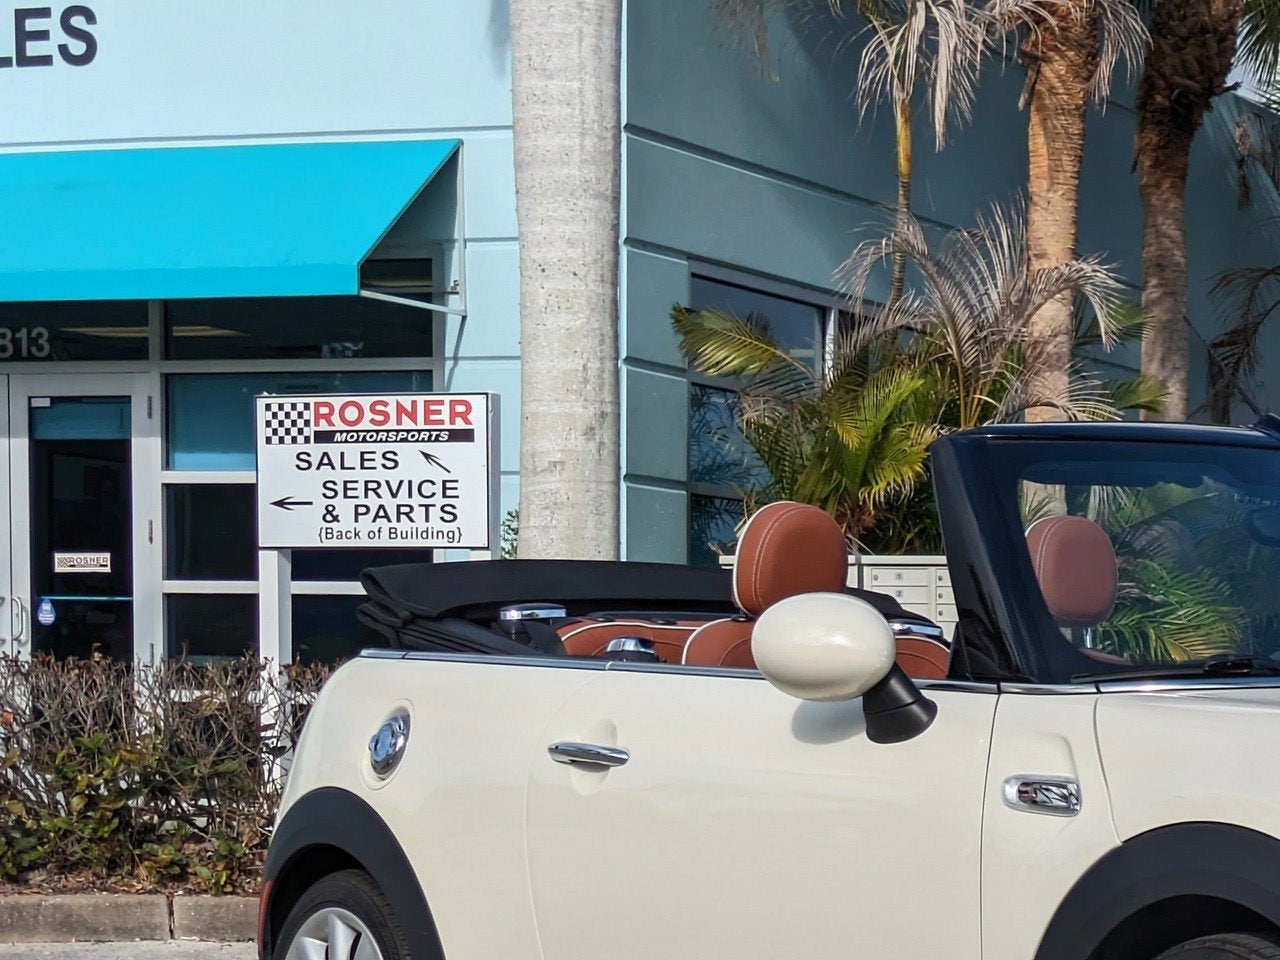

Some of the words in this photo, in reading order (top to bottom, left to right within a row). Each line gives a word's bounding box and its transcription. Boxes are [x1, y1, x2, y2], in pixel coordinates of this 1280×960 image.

[313, 399, 474, 428] ROSNER
[333, 430, 450, 443] MOTORSPORTS
[295, 450, 400, 471] SALES
[321, 479, 460, 500] SERVICE
[321, 503, 341, 523] &
[353, 503, 459, 523] PARTS
[318, 526, 361, 543] {Back
[367, 526, 383, 540] of
[388, 526, 463, 543] Building}
